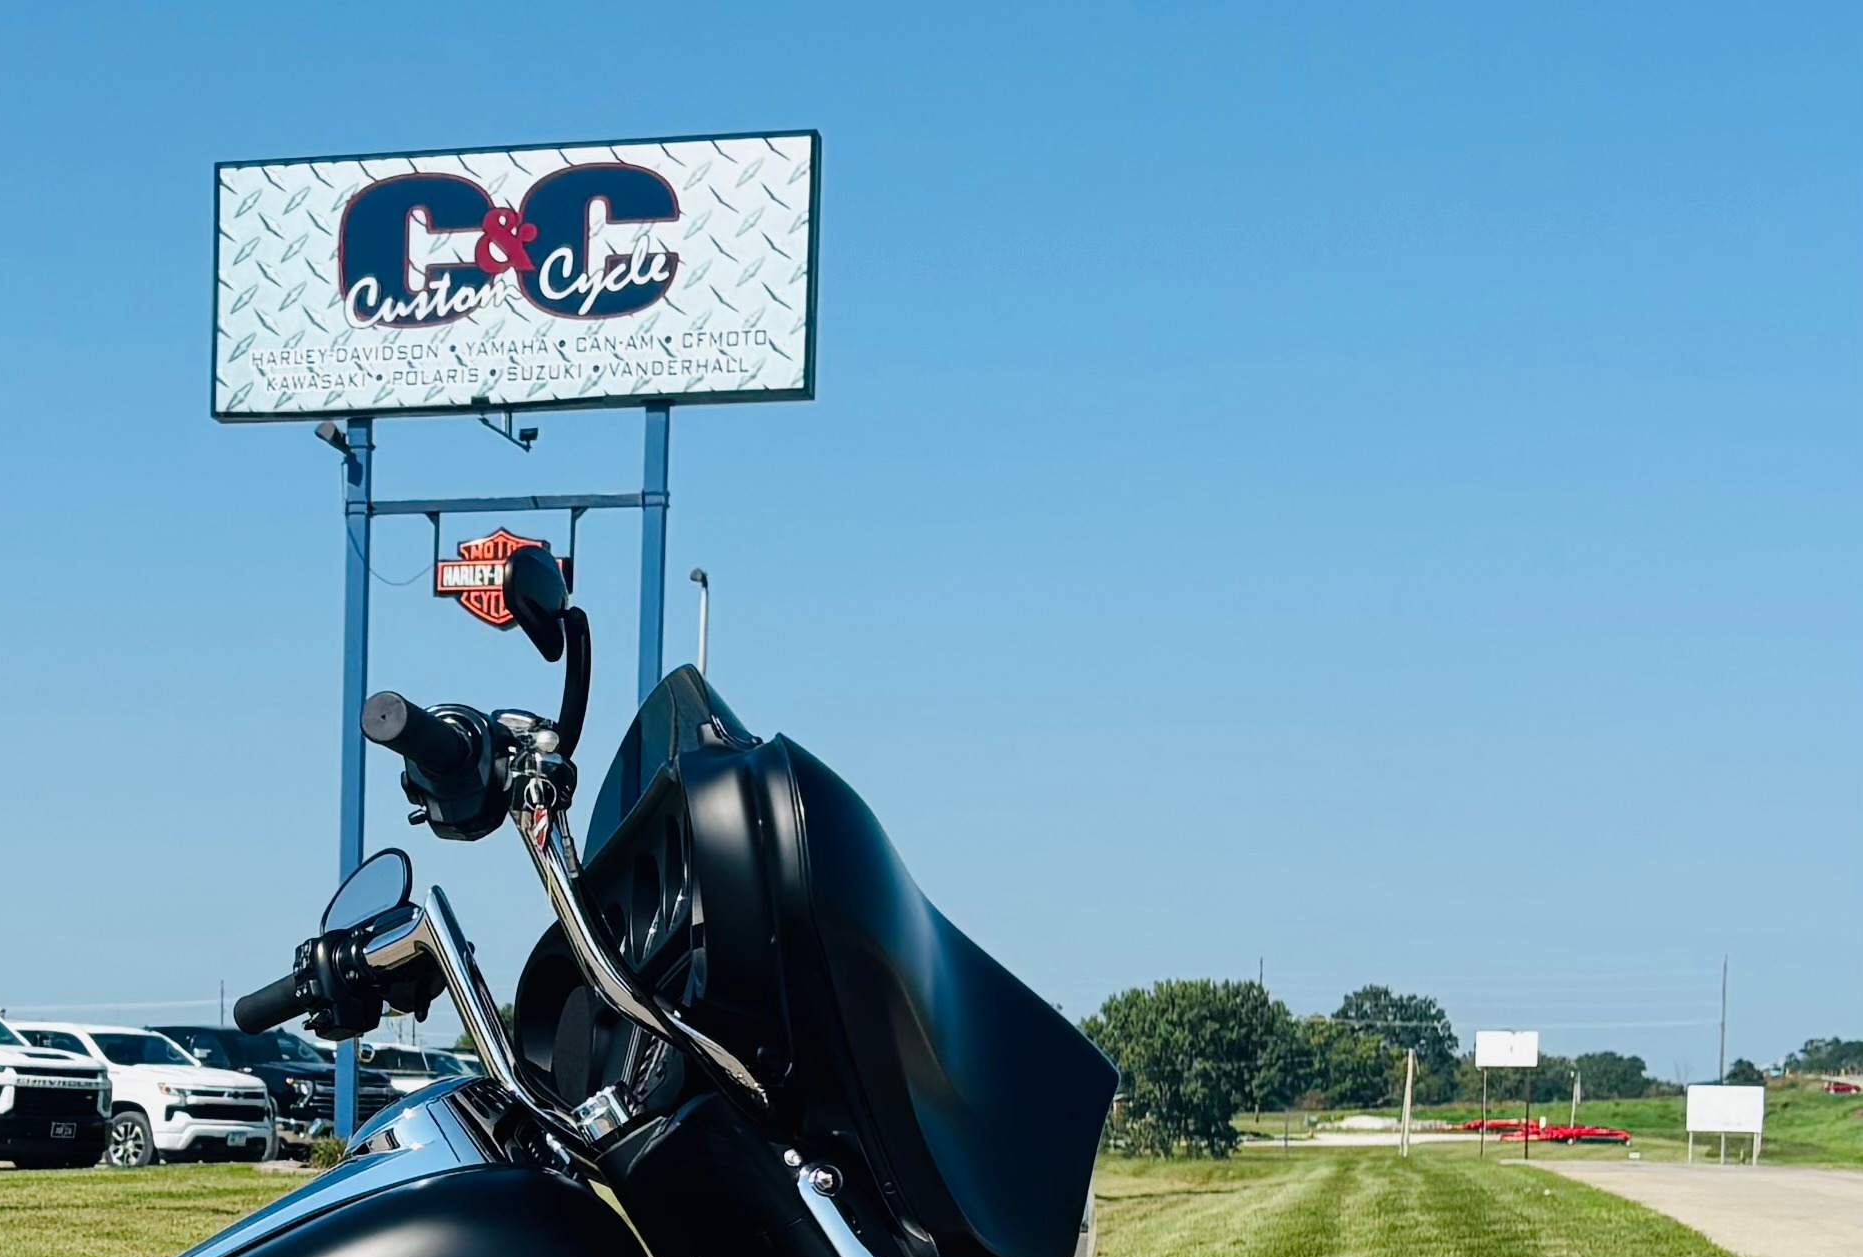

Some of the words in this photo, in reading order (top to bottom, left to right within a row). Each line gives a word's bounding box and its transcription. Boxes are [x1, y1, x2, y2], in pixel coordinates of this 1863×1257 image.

[345, 267, 526, 329] Custom
[539, 236, 671, 316] Cycle
[251, 343, 439, 367] HARLEY-DAVIDSON
[465, 338, 548, 357] YAMAHA
[575, 334, 654, 353] CAN-AM
[682, 330, 767, 349] CFMOTO
[266, 373, 366, 392] KAWASAKI
[392, 367, 479, 386] POLARIS
[507, 363, 582, 381] SUZUKI
[609, 357, 749, 378] VANDERHALL
[443, 565, 503, 586] HARLEY-D
